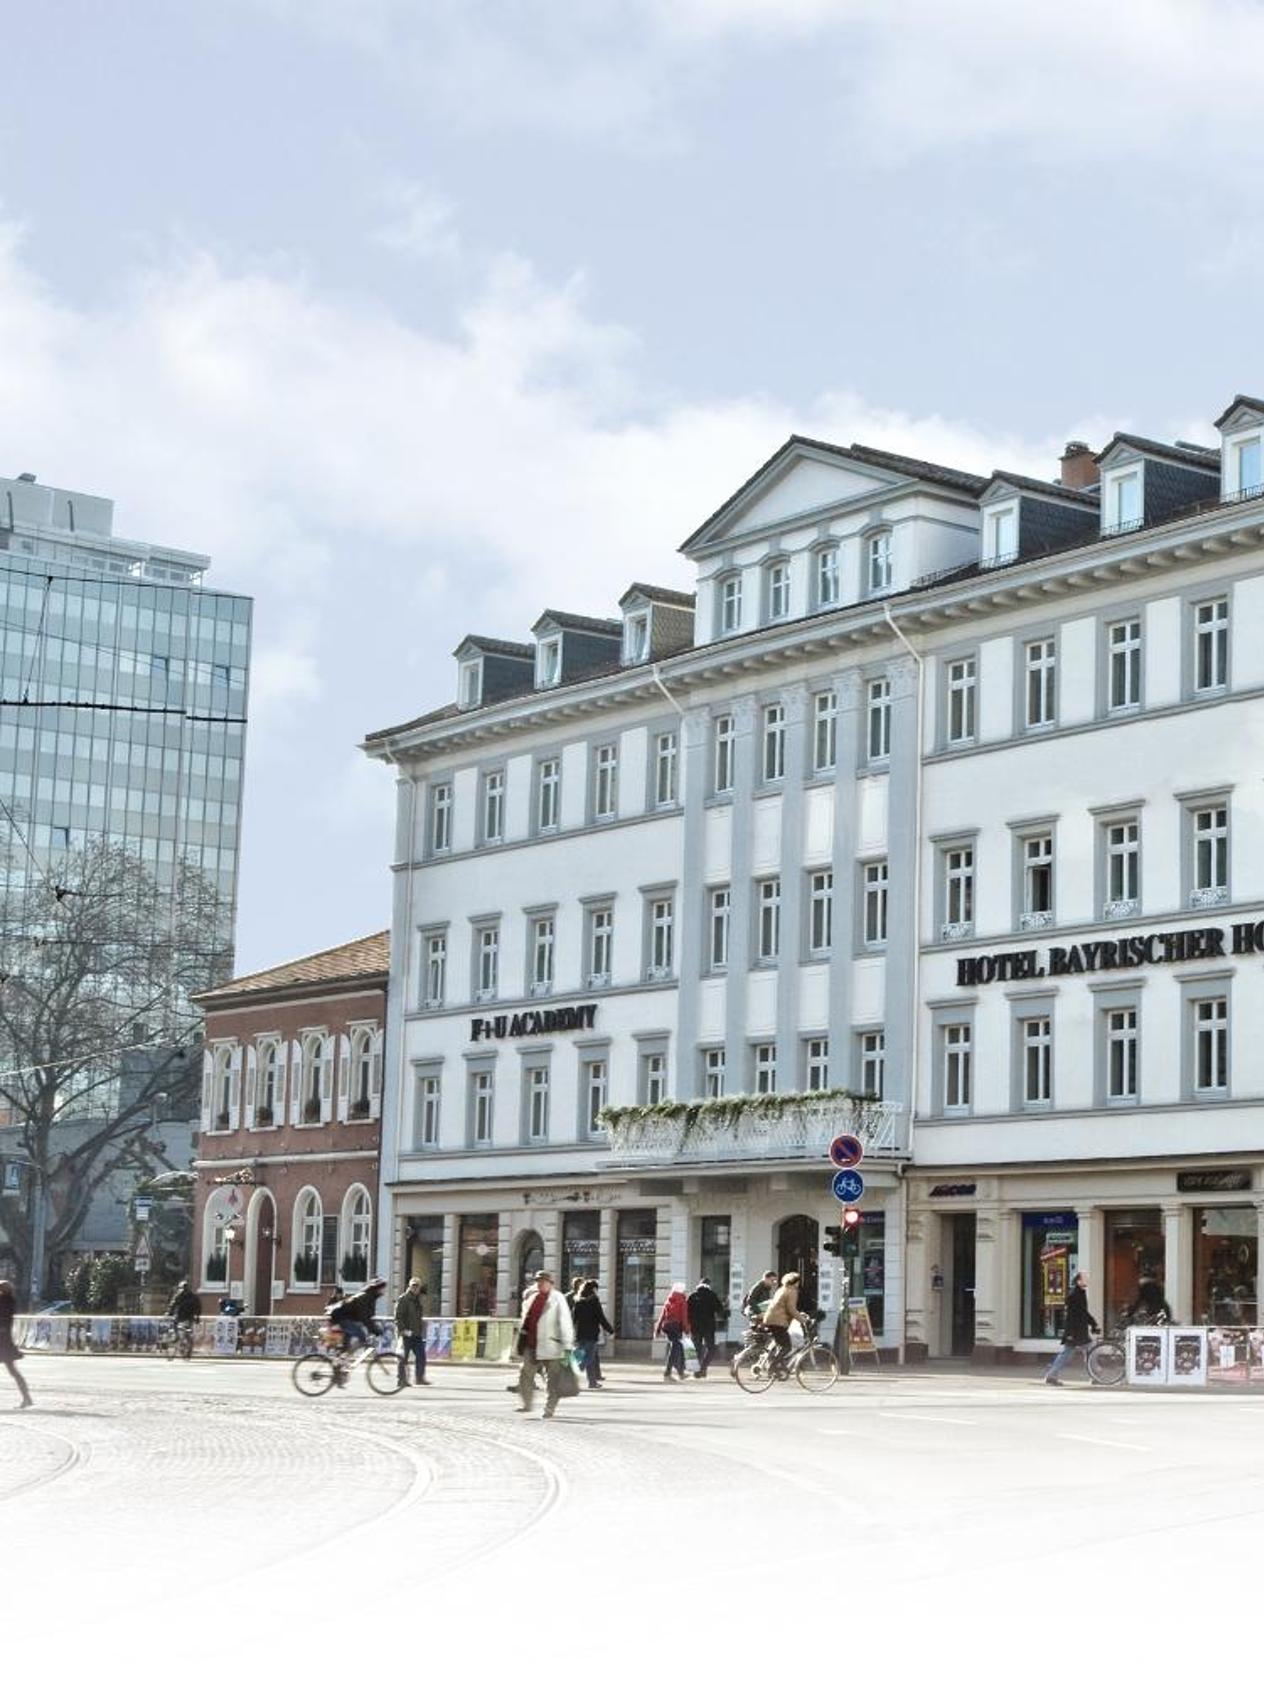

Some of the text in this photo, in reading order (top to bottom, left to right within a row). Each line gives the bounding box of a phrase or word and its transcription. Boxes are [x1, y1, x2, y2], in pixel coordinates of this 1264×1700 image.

[956, 950, 1046, 986] HOTEL
[1048, 927, 1226, 976] BAYRISCHER
[470, 1004, 598, 1041] F+U ACADEMY
